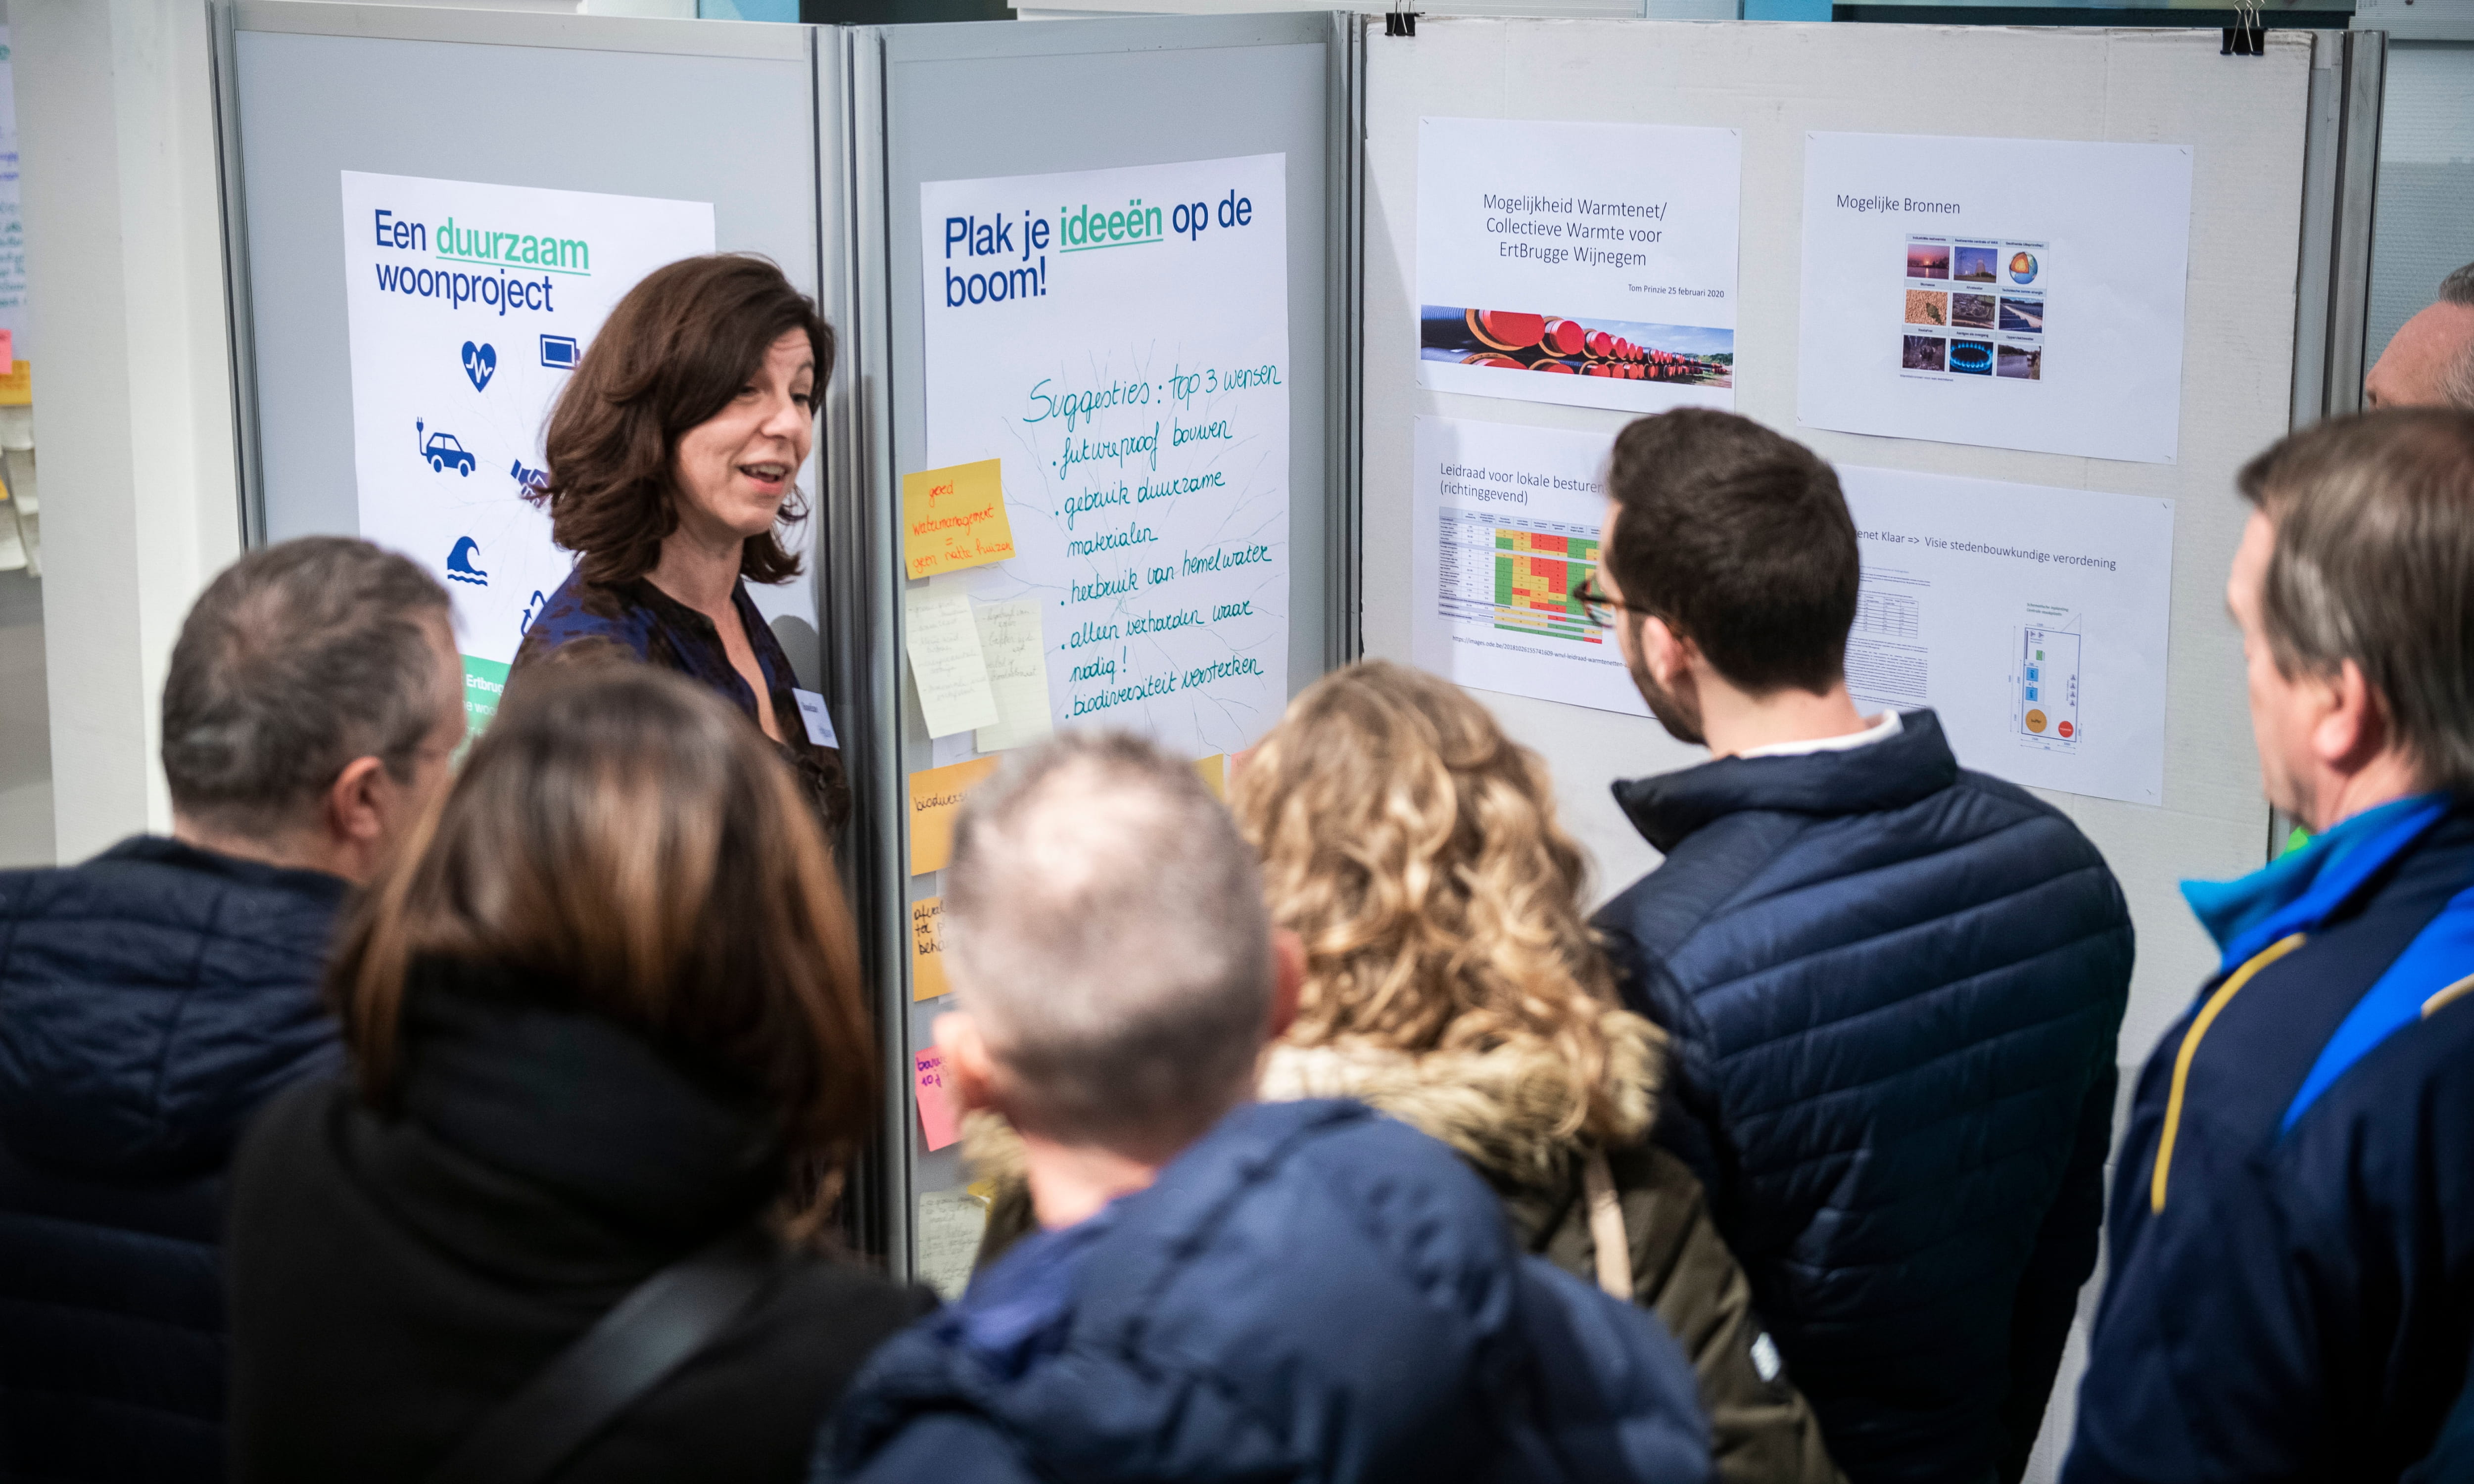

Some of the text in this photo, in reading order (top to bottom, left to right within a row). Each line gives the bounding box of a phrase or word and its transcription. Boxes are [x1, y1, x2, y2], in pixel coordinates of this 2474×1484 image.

[1483, 193, 1667, 221] Mogelijkheid Warmtenet/
[1837, 194, 1960, 214] Mogelijke Bronnen
[375, 209, 590, 270] Een duurzaam
[945, 188, 1252, 262] Plak je ideeën op de
[1486, 217, 1663, 242] Collectieve Warmte voor
[1499, 241, 1647, 268] ErtBrugge Wijnegem
[375, 263, 554, 317] woonproject
[945, 255, 1047, 308] boom!
[1628, 283, 1725, 298] Tom Prinzie 25 februari 2020
[1169, 363, 1201, 411] top
[1206, 369, 1218, 393] 3
[1224, 365, 1282, 392] wensen
[1173, 417, 1233, 447] bouwen
[928, 479, 954, 508] goed
[1440, 480, 1528, 506] (richtinggevend)
[1441, 463, 1605, 494] Leidraad voor lokale besturen
[1064, 471, 1226, 530] gebruik duurzame
[1067, 521, 1159, 558] materialen
[1856, 529, 1879, 541] enet
[1881, 531, 1905, 544] Klaar
[1925, 536, 1948, 549] Visie
[1950, 539, 2050, 562] stedenbouwkundige
[2053, 554, 2117, 572] verordening
[912, 538, 1013, 574] geen natte huizen
[1147, 566, 1175, 585] van
[1071, 600, 1253, 650] alleen verharden waar
[466, 674, 504, 696] Ertbrug
[1073, 655, 1264, 716] biodiversiteit versterken
[918, 937, 947, 955] beha
